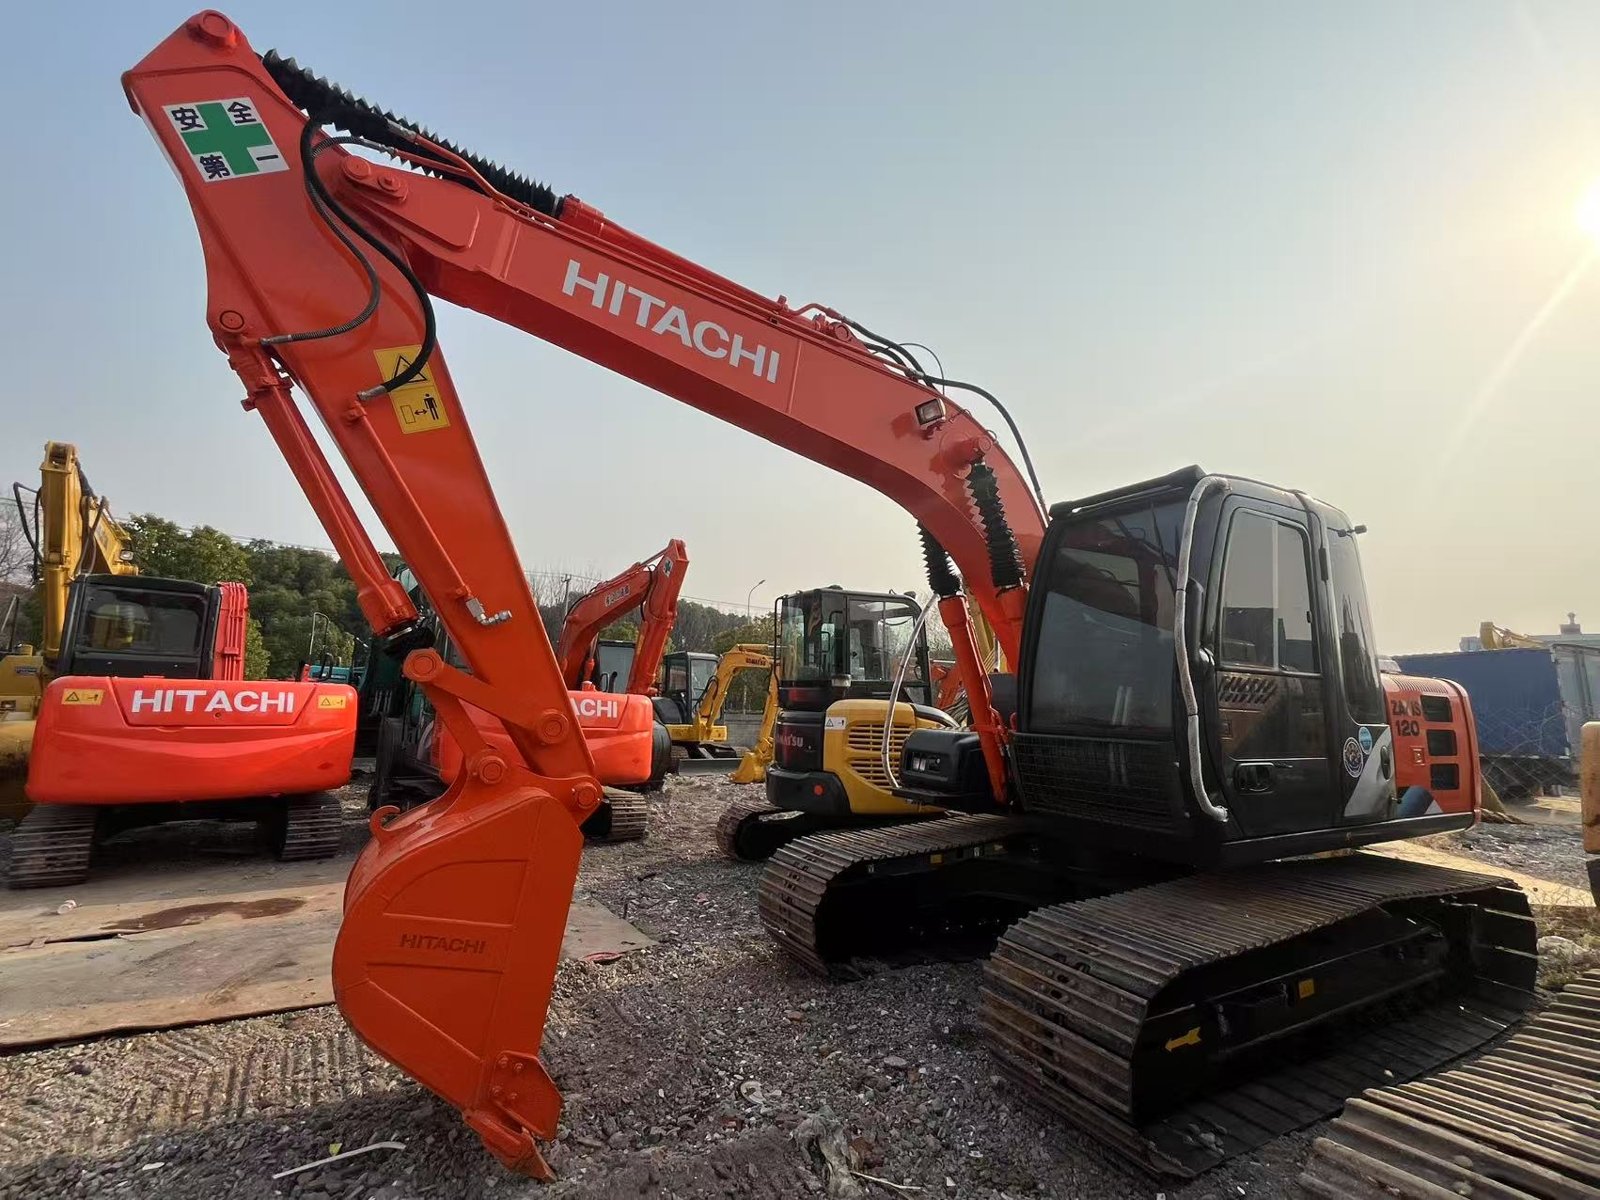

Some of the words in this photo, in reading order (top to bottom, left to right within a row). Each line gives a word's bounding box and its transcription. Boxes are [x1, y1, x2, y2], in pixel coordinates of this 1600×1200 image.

[562, 259, 781, 383] HITACHI
[131, 689, 295, 713] HITACHI
[1396, 719, 1421, 737] 120
[400, 933, 487, 954] HITACHI
